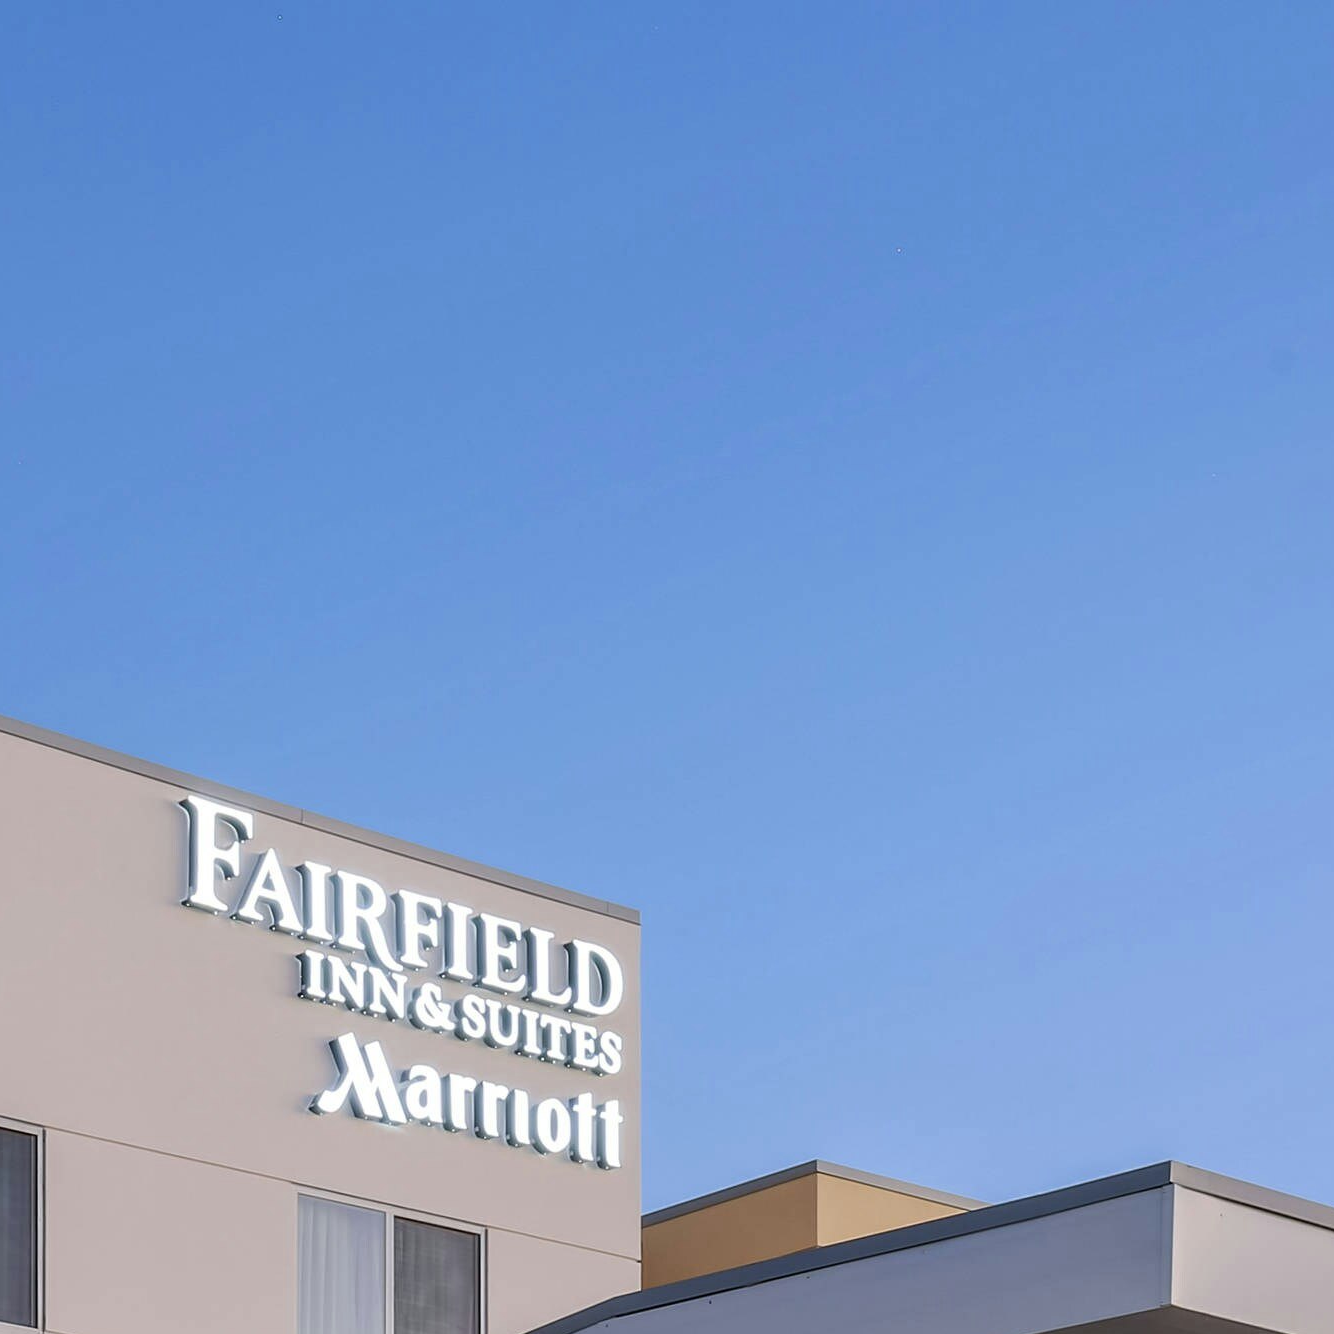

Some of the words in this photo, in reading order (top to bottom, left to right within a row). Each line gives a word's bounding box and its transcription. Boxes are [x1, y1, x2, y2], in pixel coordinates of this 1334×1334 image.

[180, 795, 624, 1017] FAIRFIELD
[296, 949, 408, 1022] INN
[409, 982, 457, 1034] &
[457, 993, 623, 1077] SUITES
[309, 1032, 624, 1170] Marriott
